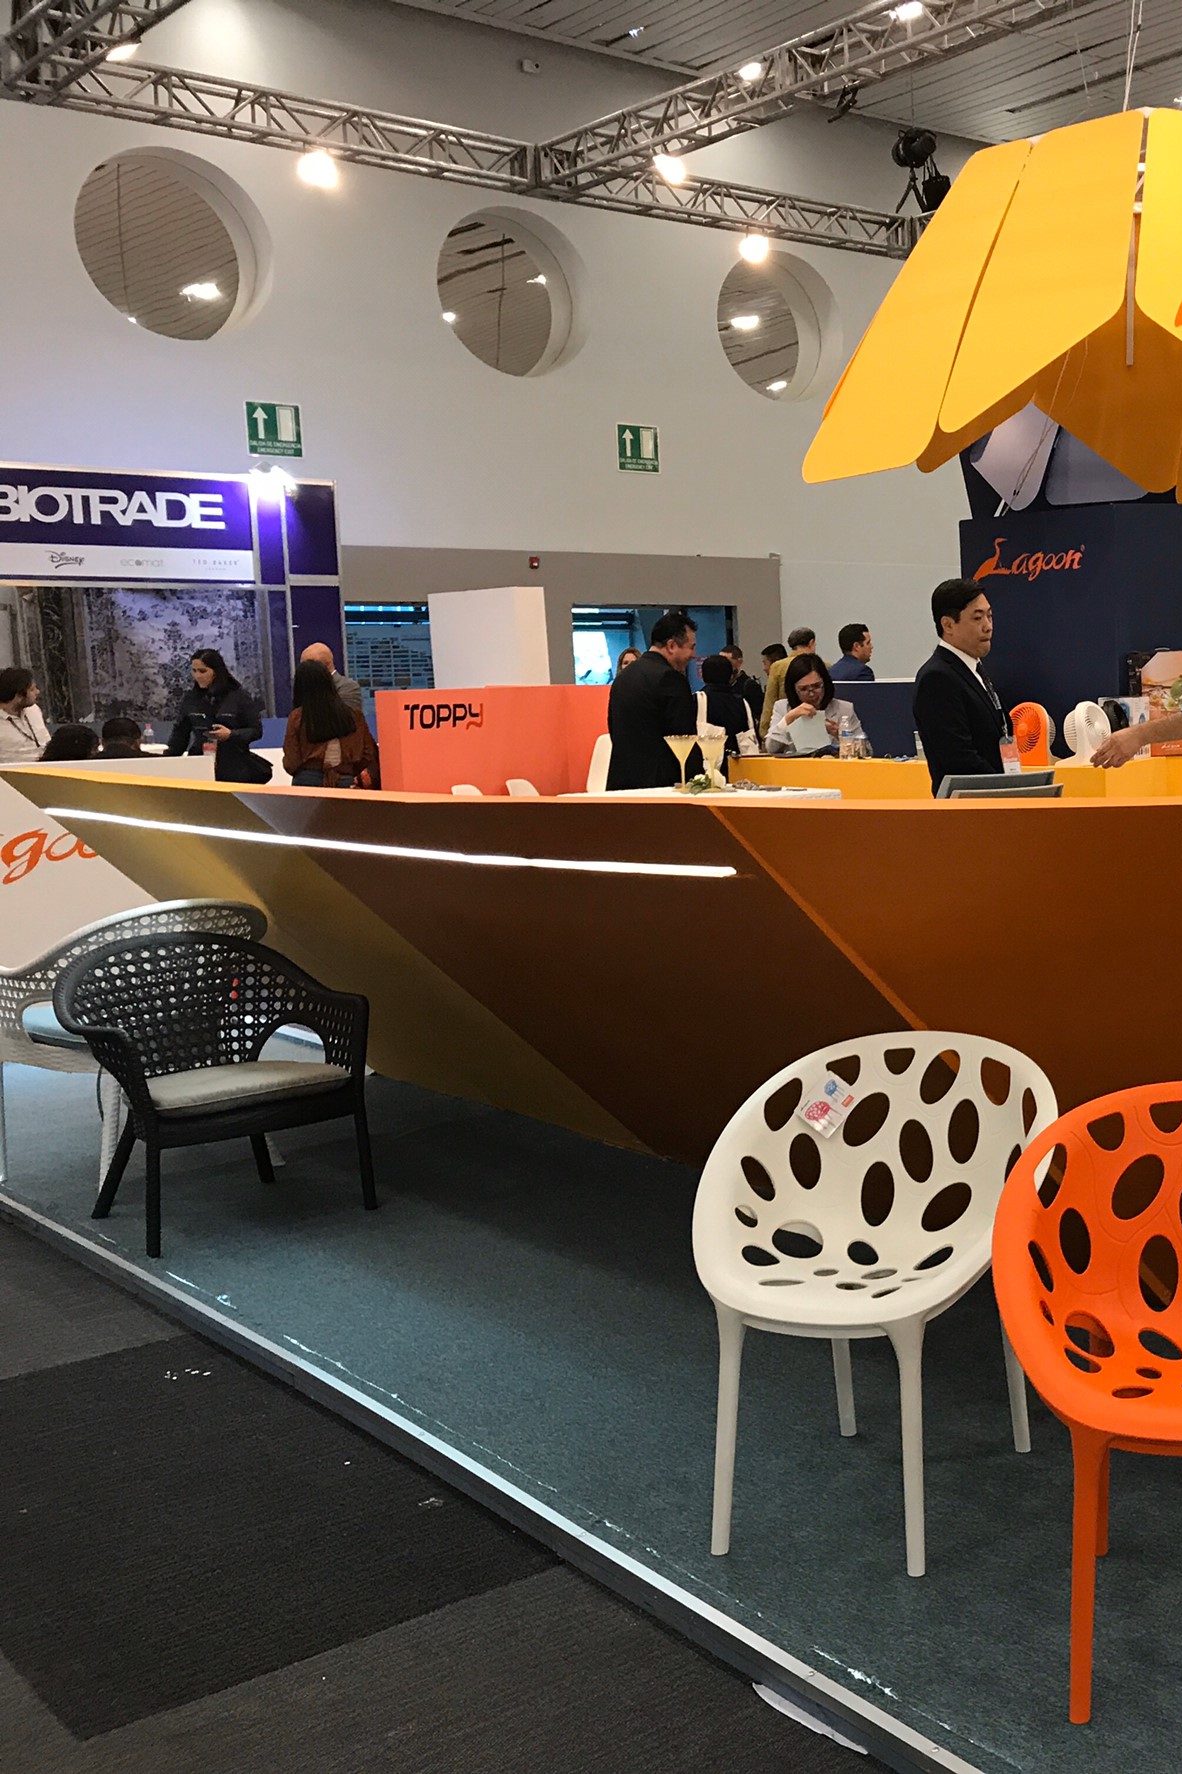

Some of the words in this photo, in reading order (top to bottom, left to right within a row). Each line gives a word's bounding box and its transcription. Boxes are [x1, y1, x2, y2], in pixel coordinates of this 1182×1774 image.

[0, 485, 226, 530] BIOTRADE
[973, 537, 1084, 582] Lagoon
[404, 703, 483, 730] TOPPY
